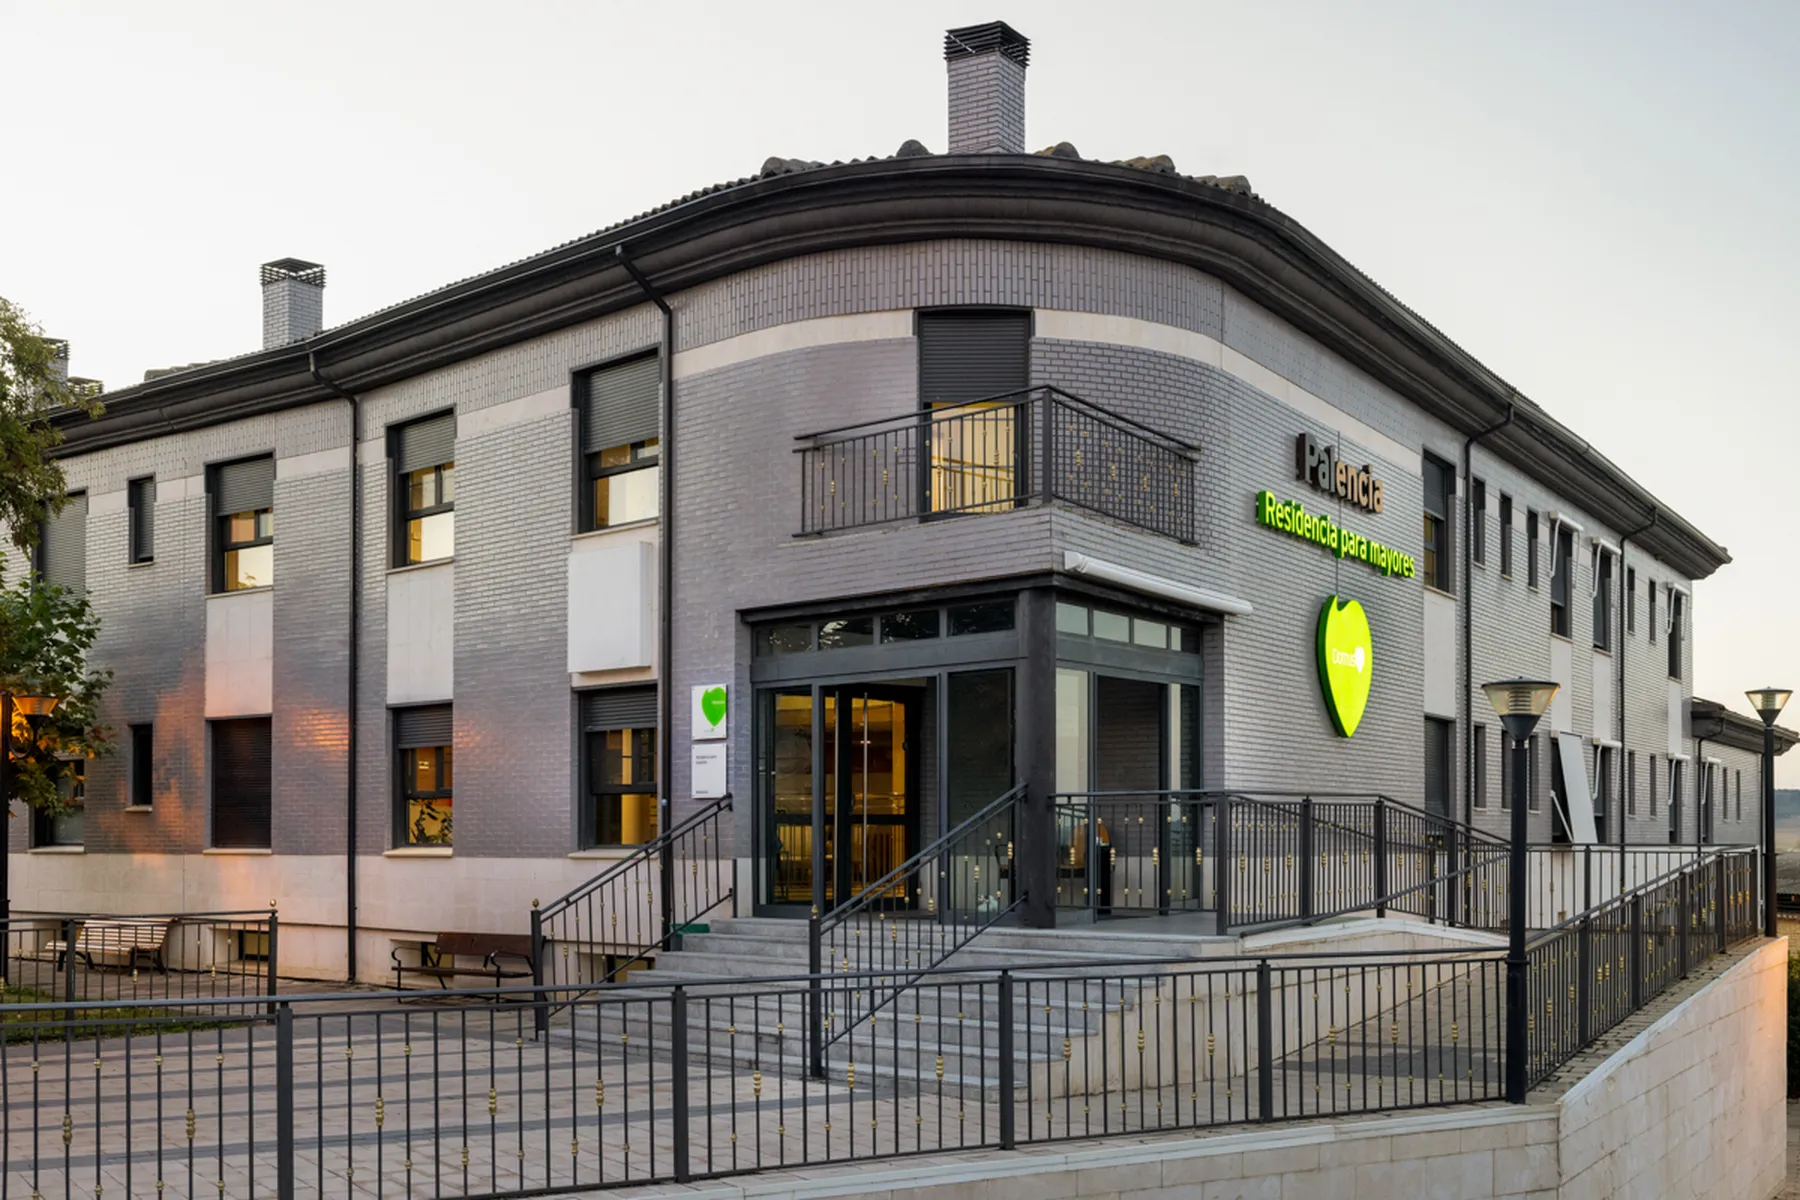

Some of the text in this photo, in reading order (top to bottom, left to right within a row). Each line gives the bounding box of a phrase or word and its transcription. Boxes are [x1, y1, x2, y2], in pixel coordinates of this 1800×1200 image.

[1299, 433, 1384, 513] Palencia
[1260, 490, 1415, 578] Residencia para mayores
